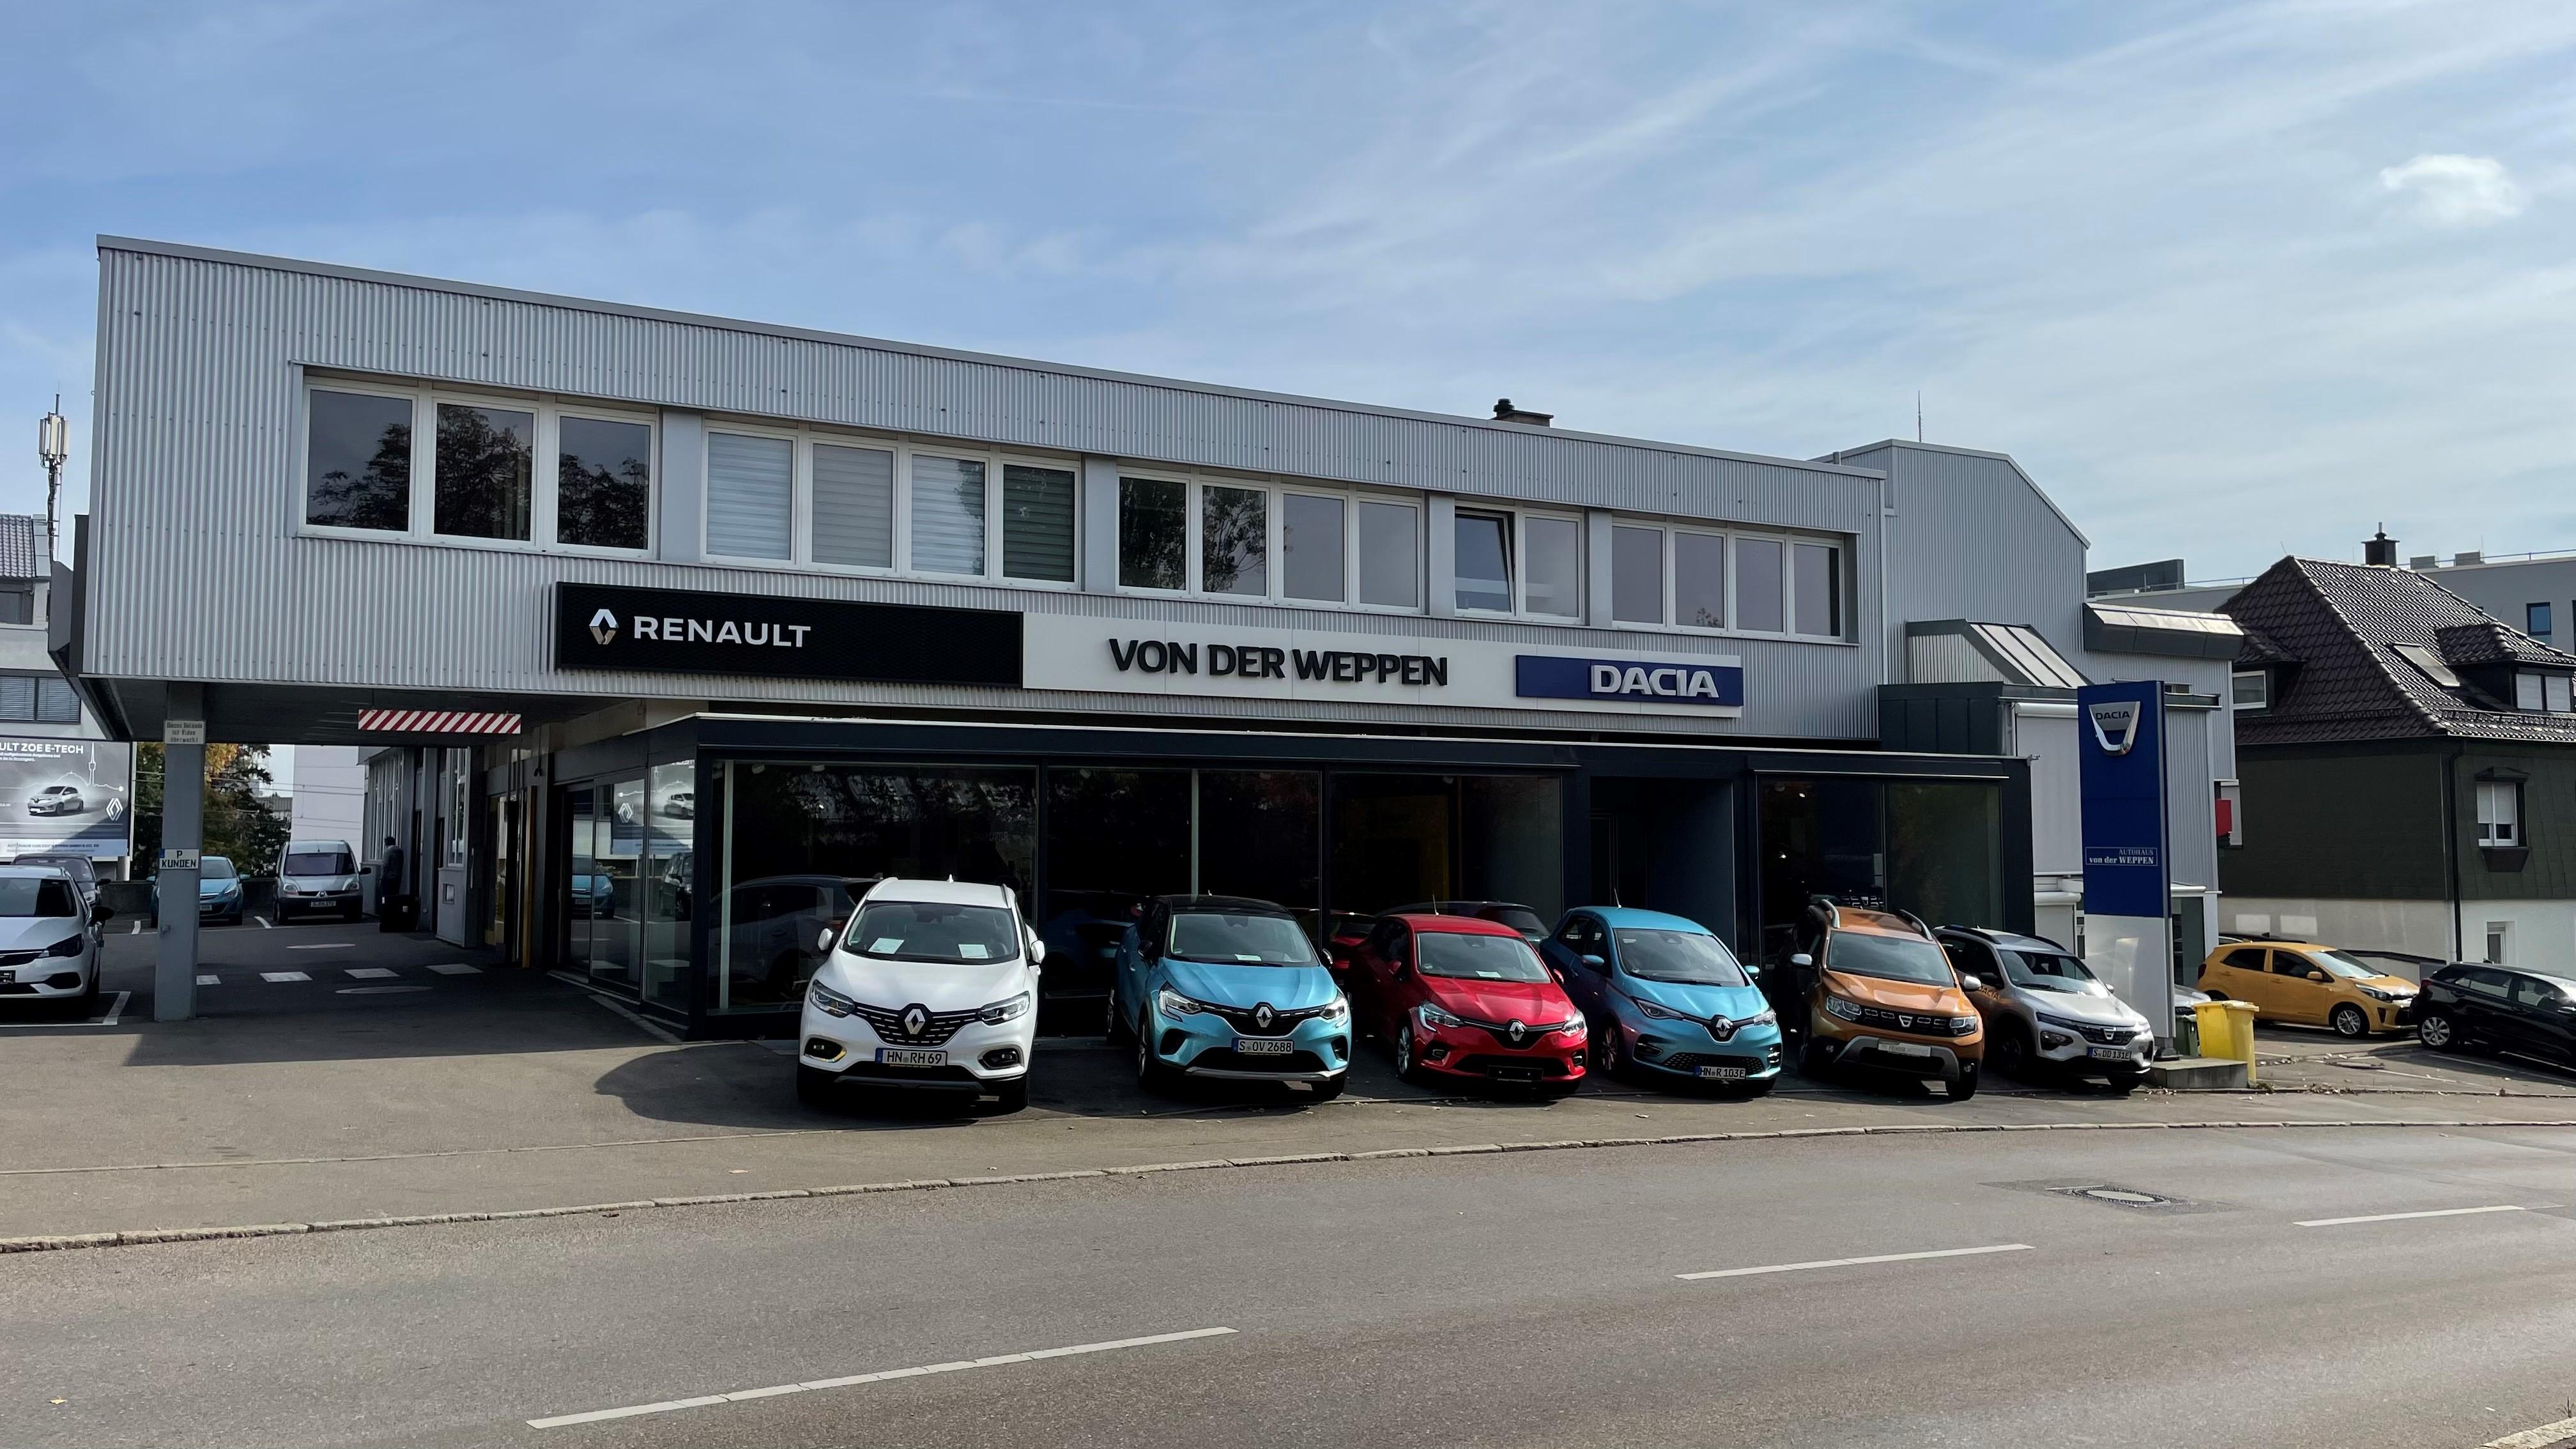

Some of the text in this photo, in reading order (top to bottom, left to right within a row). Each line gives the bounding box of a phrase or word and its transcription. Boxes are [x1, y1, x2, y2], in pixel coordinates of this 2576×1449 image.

[634, 616, 811, 647] RENAULT
[1108, 638, 1448, 686] VON DER WEPPEN
[1591, 664, 1719, 698] DACIA
[2096, 710, 2131, 720] DACIA
[20, 743, 43, 752] ZOE
[45, 744, 84, 754] E-TECH
[176, 850, 183, 859] P
[162, 859, 196, 868] KUNDEN
[2119, 856, 2154, 864] WEPPEN
[1267, 1042, 1292, 1052] 2688
[887, 1051, 942, 1064] HN RH 69
[1699, 1068, 1712, 1077] HN
